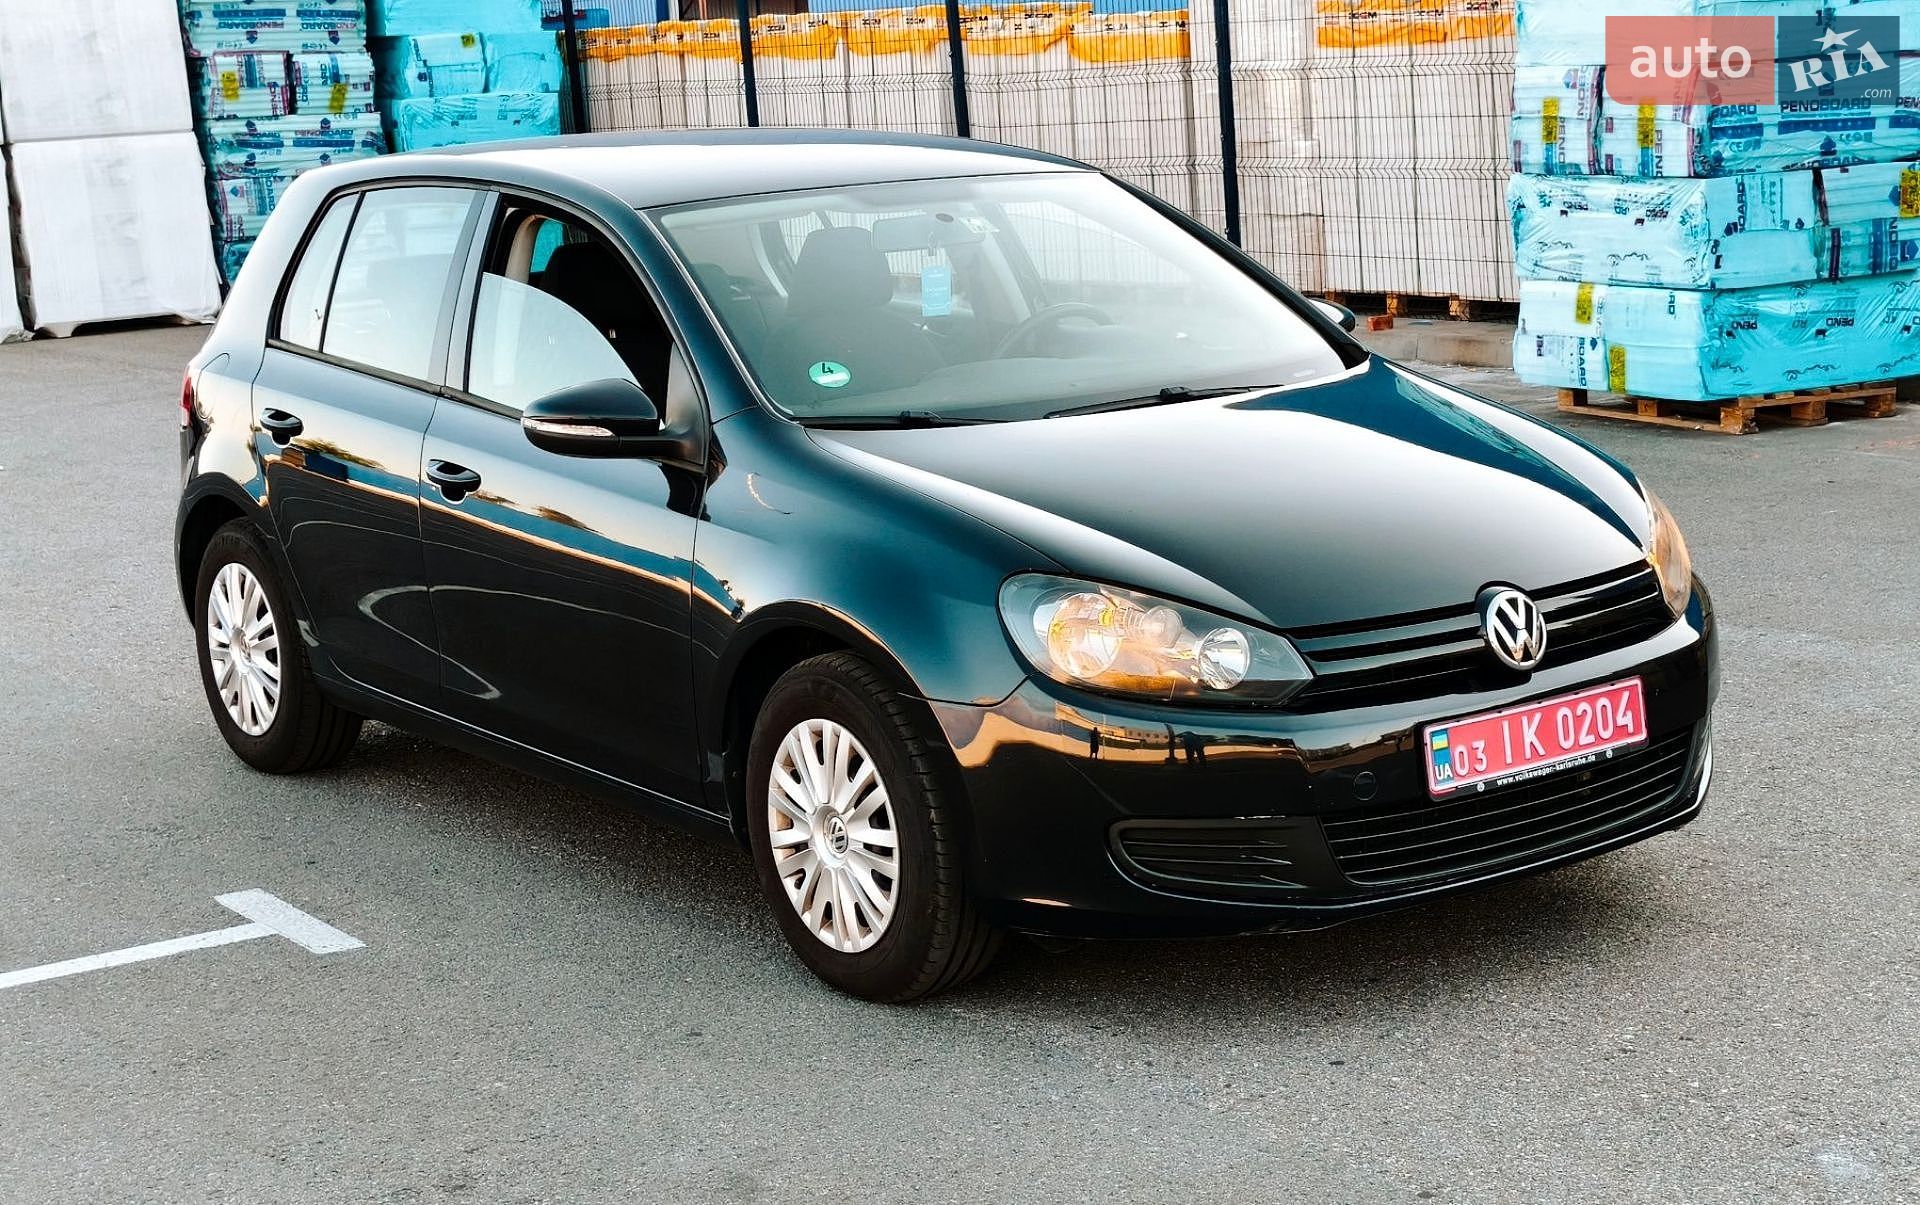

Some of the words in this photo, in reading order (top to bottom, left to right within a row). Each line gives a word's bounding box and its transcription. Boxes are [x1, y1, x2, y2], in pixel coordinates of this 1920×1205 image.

[822, 363, 833, 373] 4
[1454, 740, 1487, 776] 03
[1502, 712, 1546, 766] IK
[1556, 691, 1633, 750] 0204
[1435, 763, 1453, 780] UA
